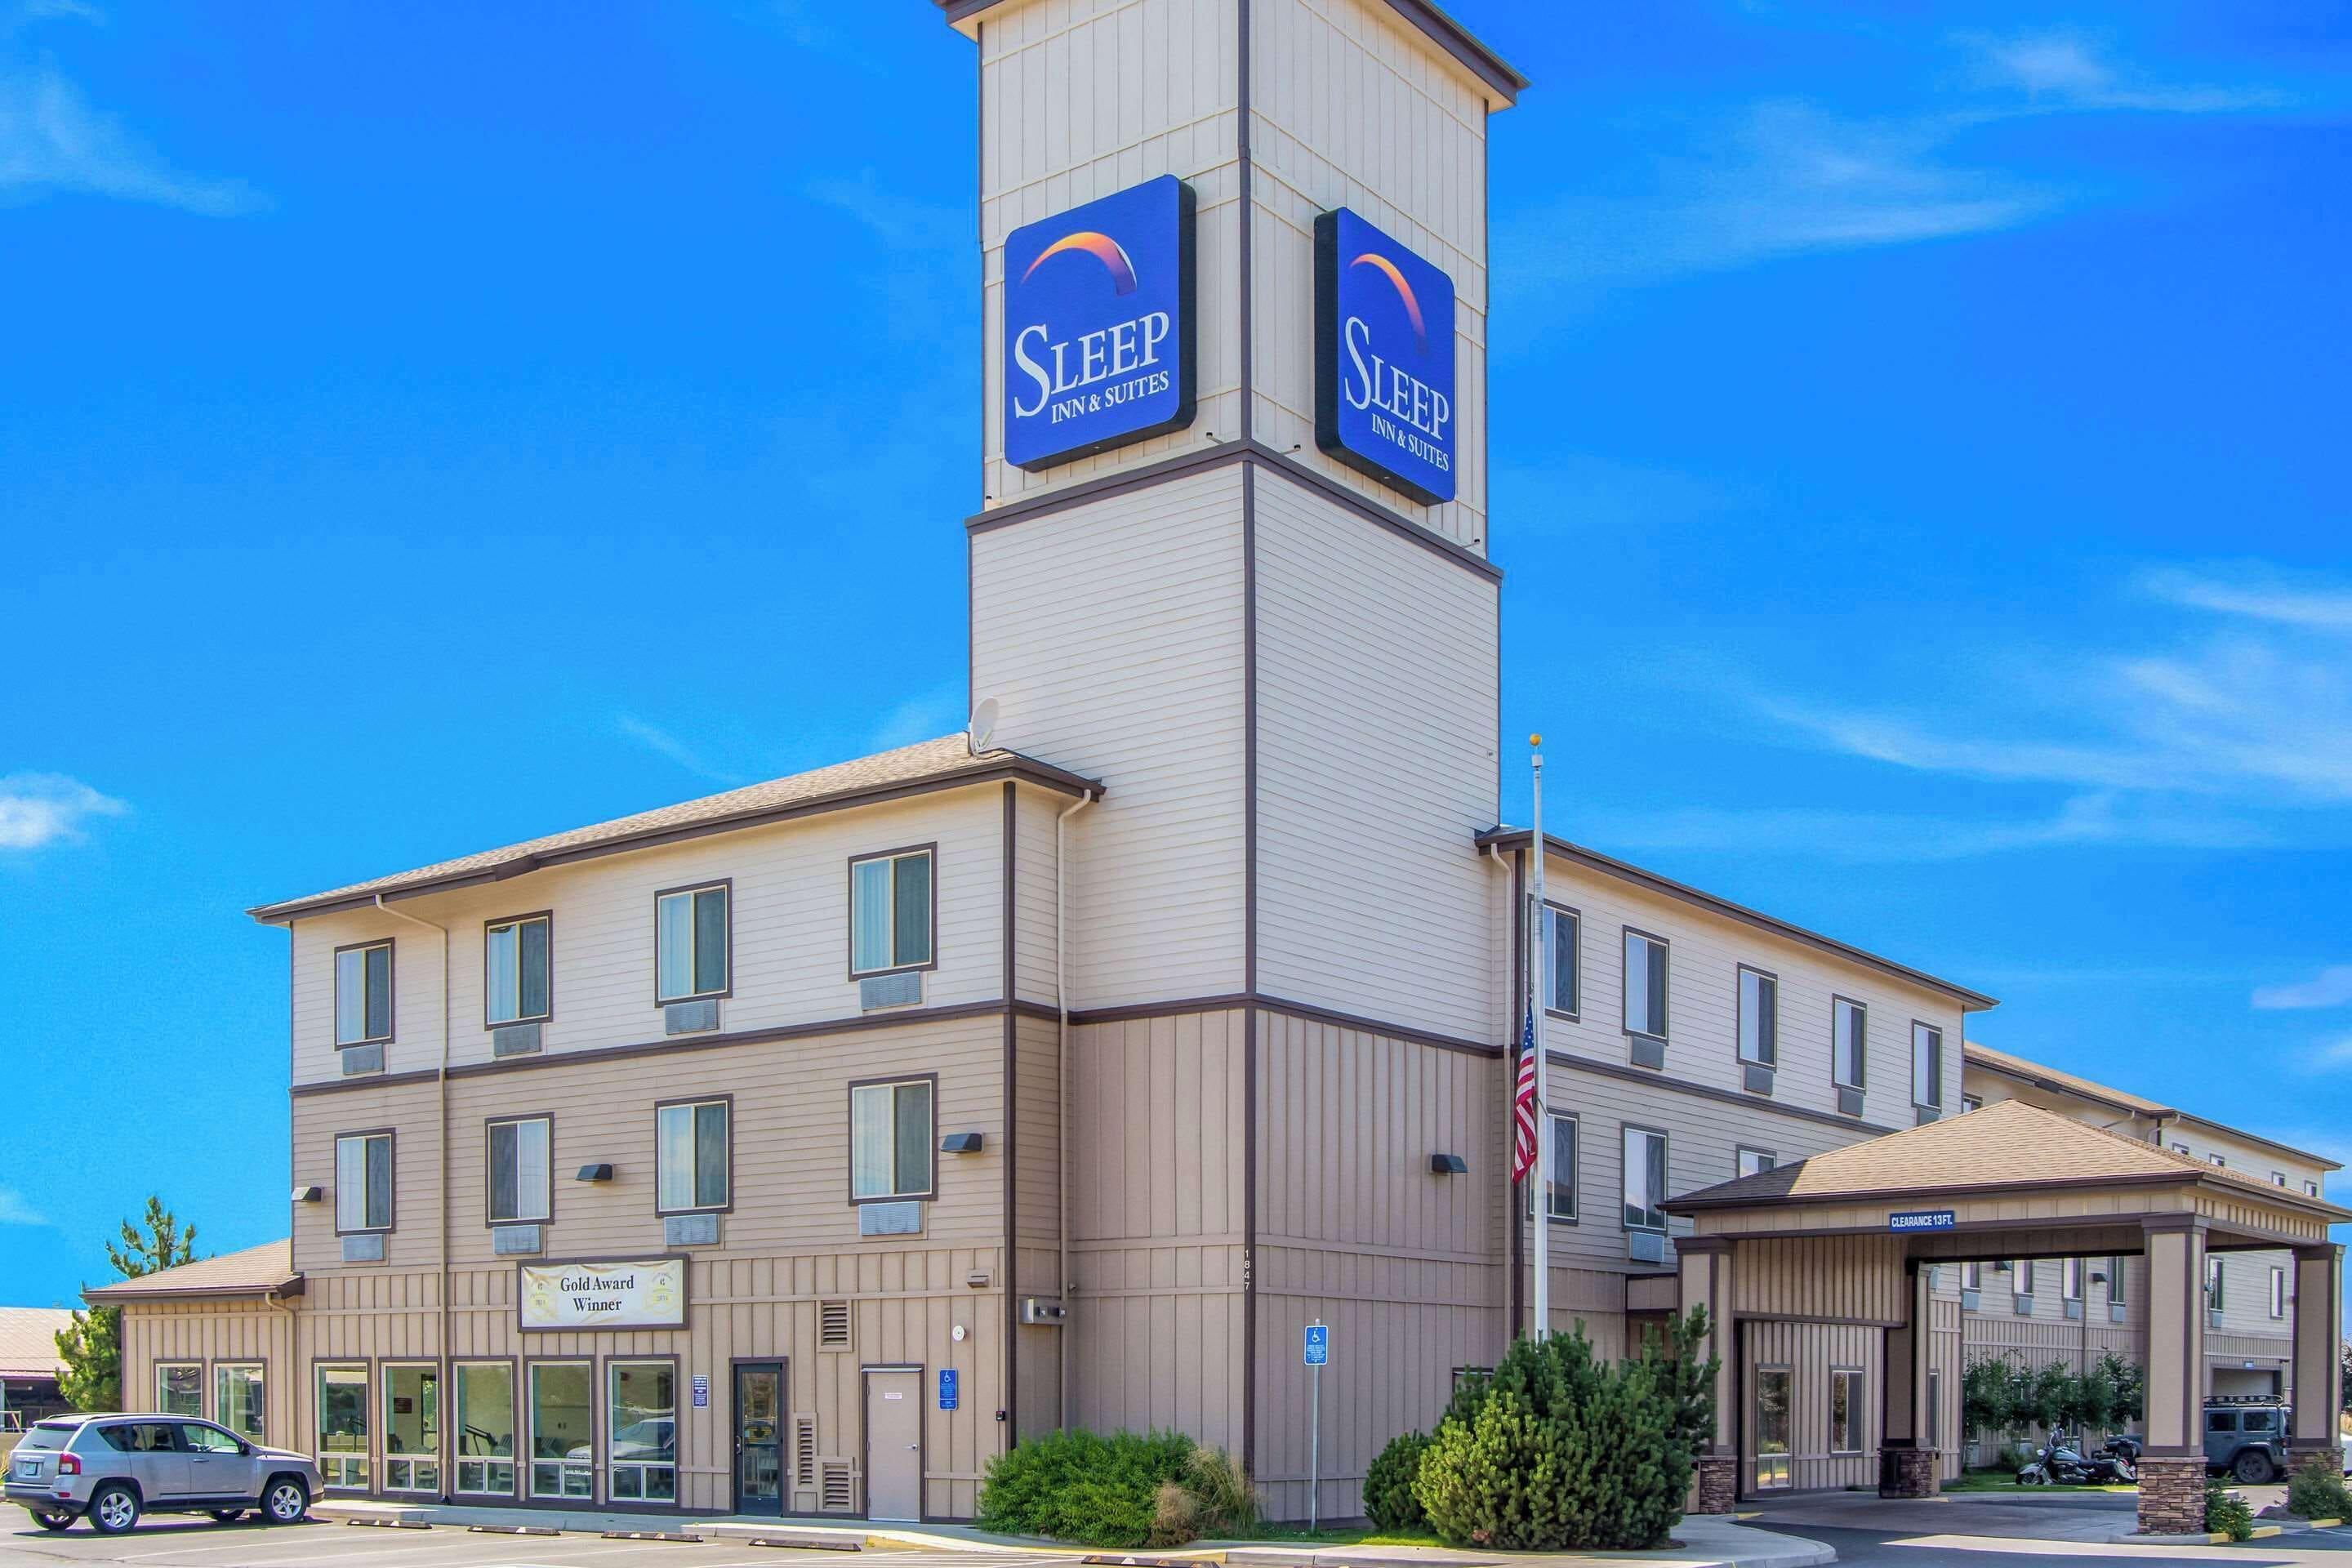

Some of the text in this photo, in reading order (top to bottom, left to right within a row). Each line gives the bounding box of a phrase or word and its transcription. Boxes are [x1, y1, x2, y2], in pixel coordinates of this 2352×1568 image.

[1014, 311, 1169, 419] SLEEP
[1344, 316, 1450, 441] SLEEP
[1051, 370, 1169, 424] INN & SUITES
[1372, 412, 1450, 471] INN & SUITES
[1891, 1215, 1932, 1227] CLEARANCE
[1932, 1214, 1942, 1226] 13
[560, 1276, 590, 1292] Gold
[591, 1275, 635, 1290] Award
[572, 1297, 622, 1312] Winner
